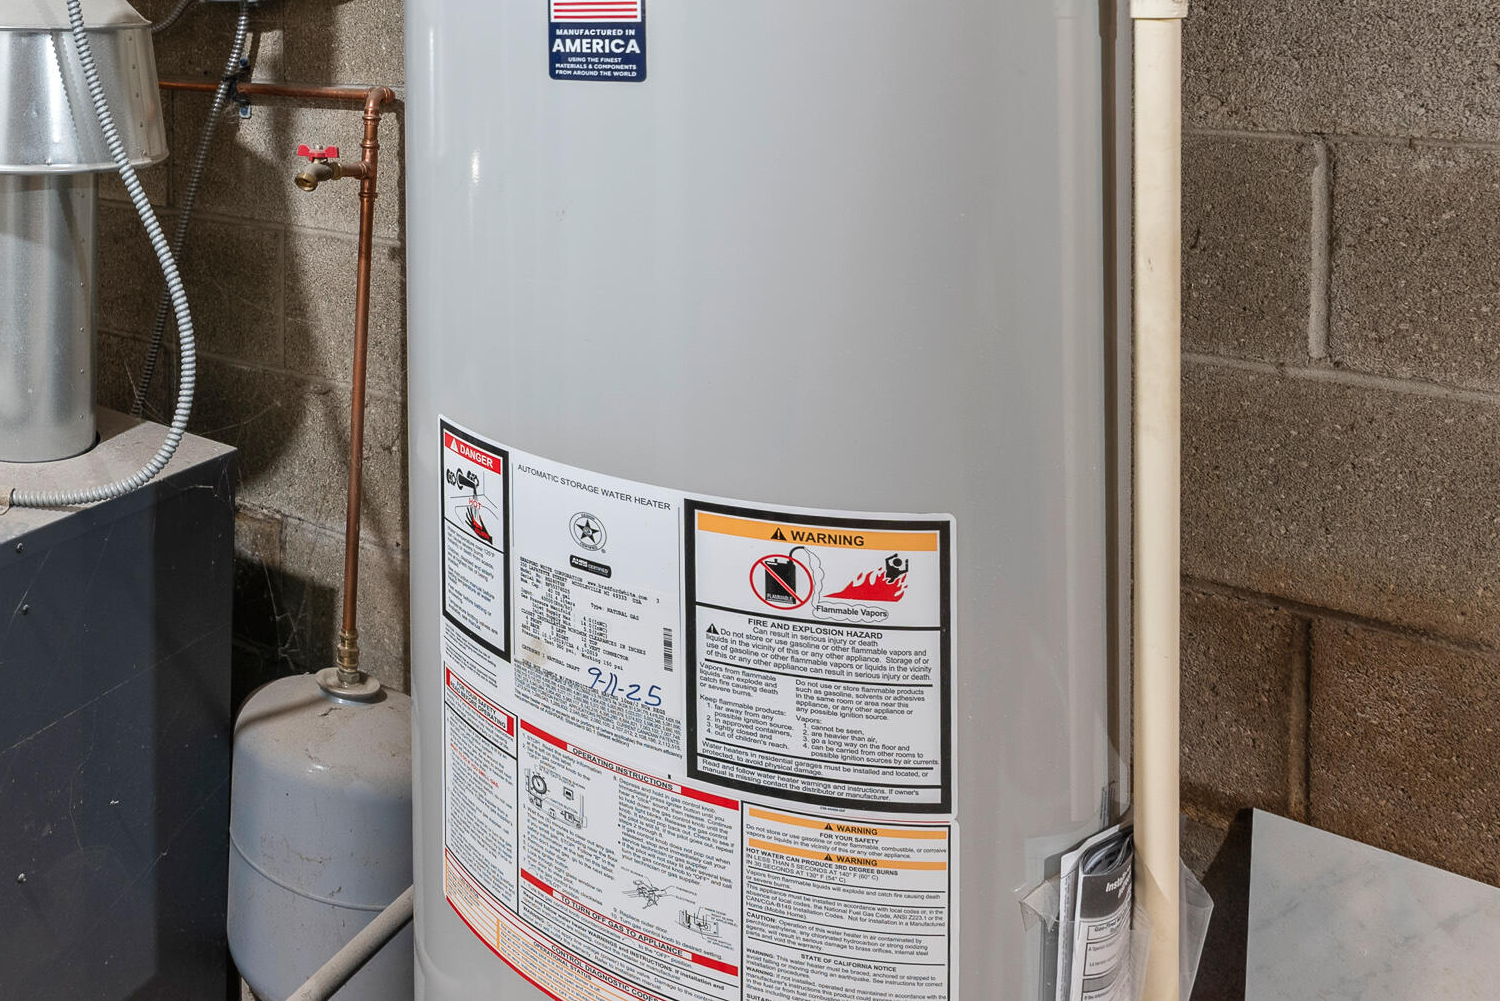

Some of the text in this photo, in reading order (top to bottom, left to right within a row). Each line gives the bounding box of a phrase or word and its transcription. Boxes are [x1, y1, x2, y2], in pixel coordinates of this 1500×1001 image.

[552, 39, 640, 53] AMERICA
[460, 444, 493, 468] DANGER
[518, 465, 670, 510] AUTOMATIC STORAGE WATER HEATER
[469, 498, 482, 510] HOT
[791, 530, 864, 546] WARNING
[816, 605, 888, 617] Flammable Vapors
[748, 618, 768, 627] FIRE
[792, 625, 844, 636] EXPLOSION
[828, 637, 848, 645] injury
[706, 634, 728, 643] liquids
[752, 643, 776, 652] vicinity
[886, 657, 912, 665] Storage
[851, 647, 888, 655] flammable
[773, 663, 808, 672] appliance
[588, 667, 661, 706] 9-11-25
[478, 699, 496, 715] SAFETY
[478, 706, 506, 728] OPERATING
[573, 748, 673, 789] OPERATING INSTRUCTIONS
[837, 824, 878, 835] WARNING
[761, 851, 784, 860] WATER
[801, 859, 833, 868] PRODUCE
[837, 856, 878, 866] WARNING
[562, 896, 682, 955] TO TURN OFF GAS TO APPLIANCE
[746, 912, 777, 923] CAUTION:
[534, 942, 591, 980] OPERATIONAL STATUS
[552, 945, 583, 968] CONTROL
[585, 965, 630, 990] DIAGNOSTIC
[834, 960, 872, 969] CALIFORNIA
